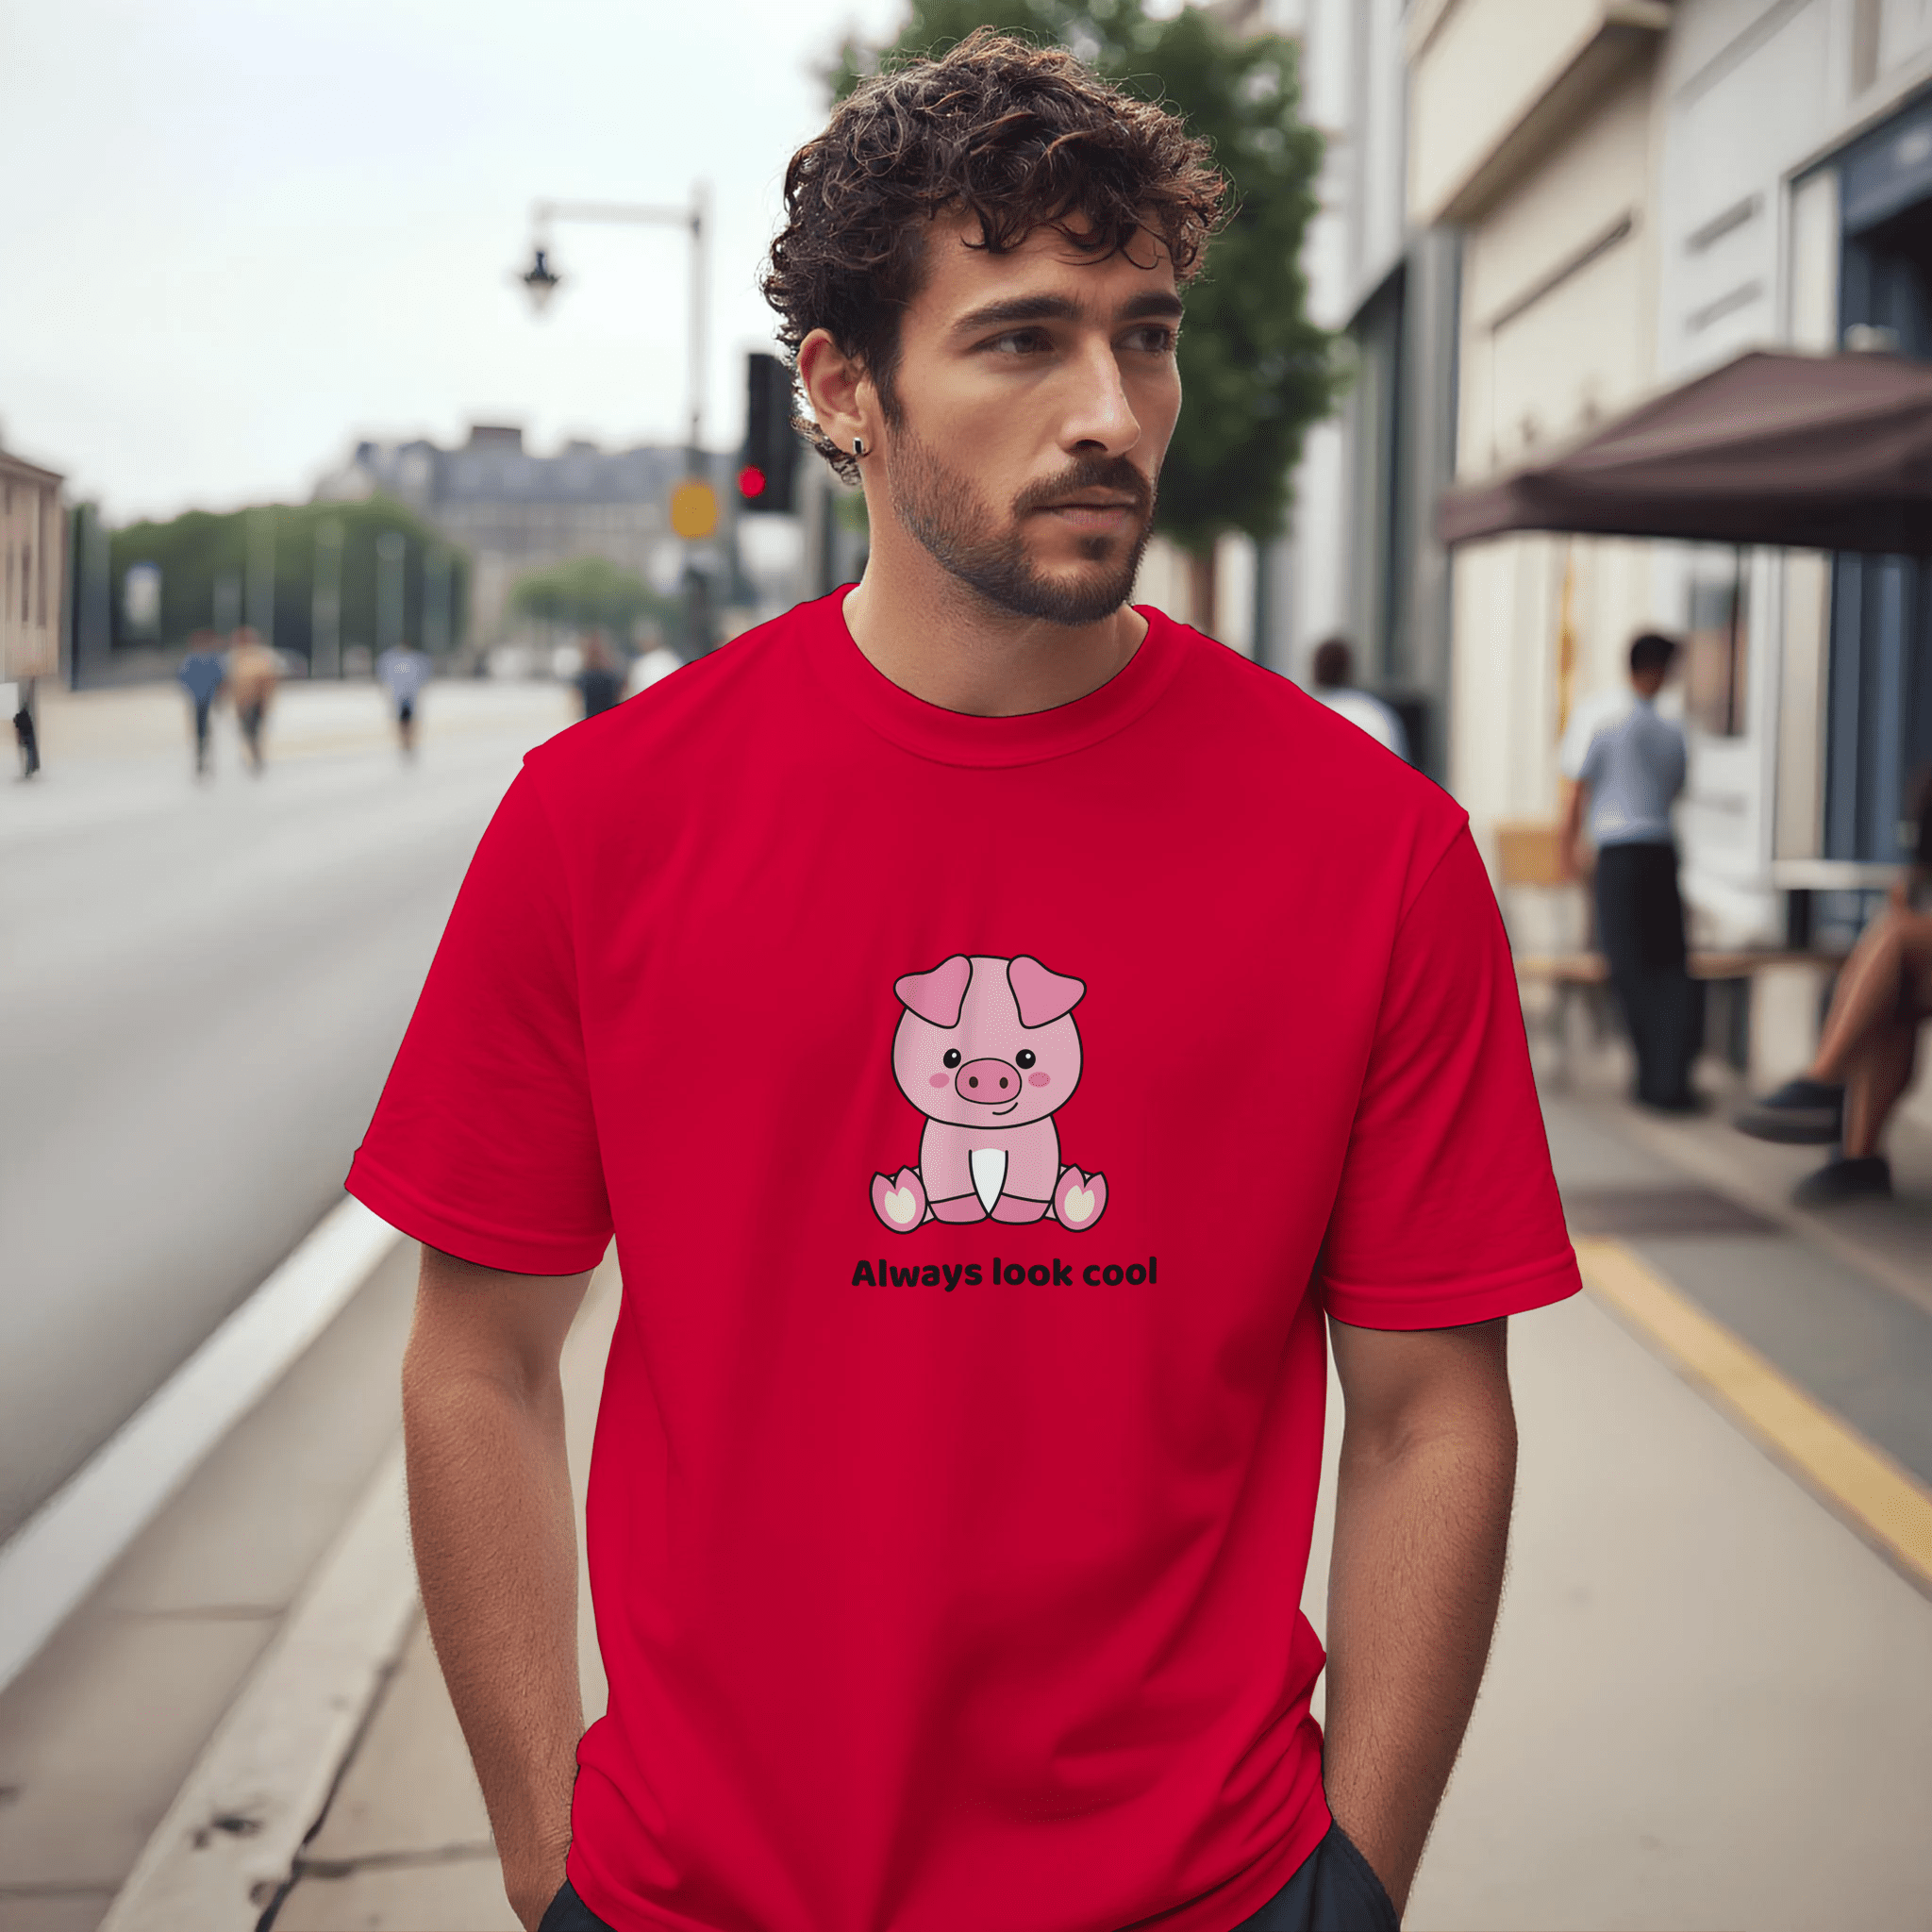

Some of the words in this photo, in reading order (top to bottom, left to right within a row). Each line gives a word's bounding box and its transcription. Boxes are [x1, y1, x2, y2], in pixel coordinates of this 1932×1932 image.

[851, 1258, 983, 1292] Always
[992, 1257, 1074, 1287] look
[1082, 1256, 1158, 1287] cool
